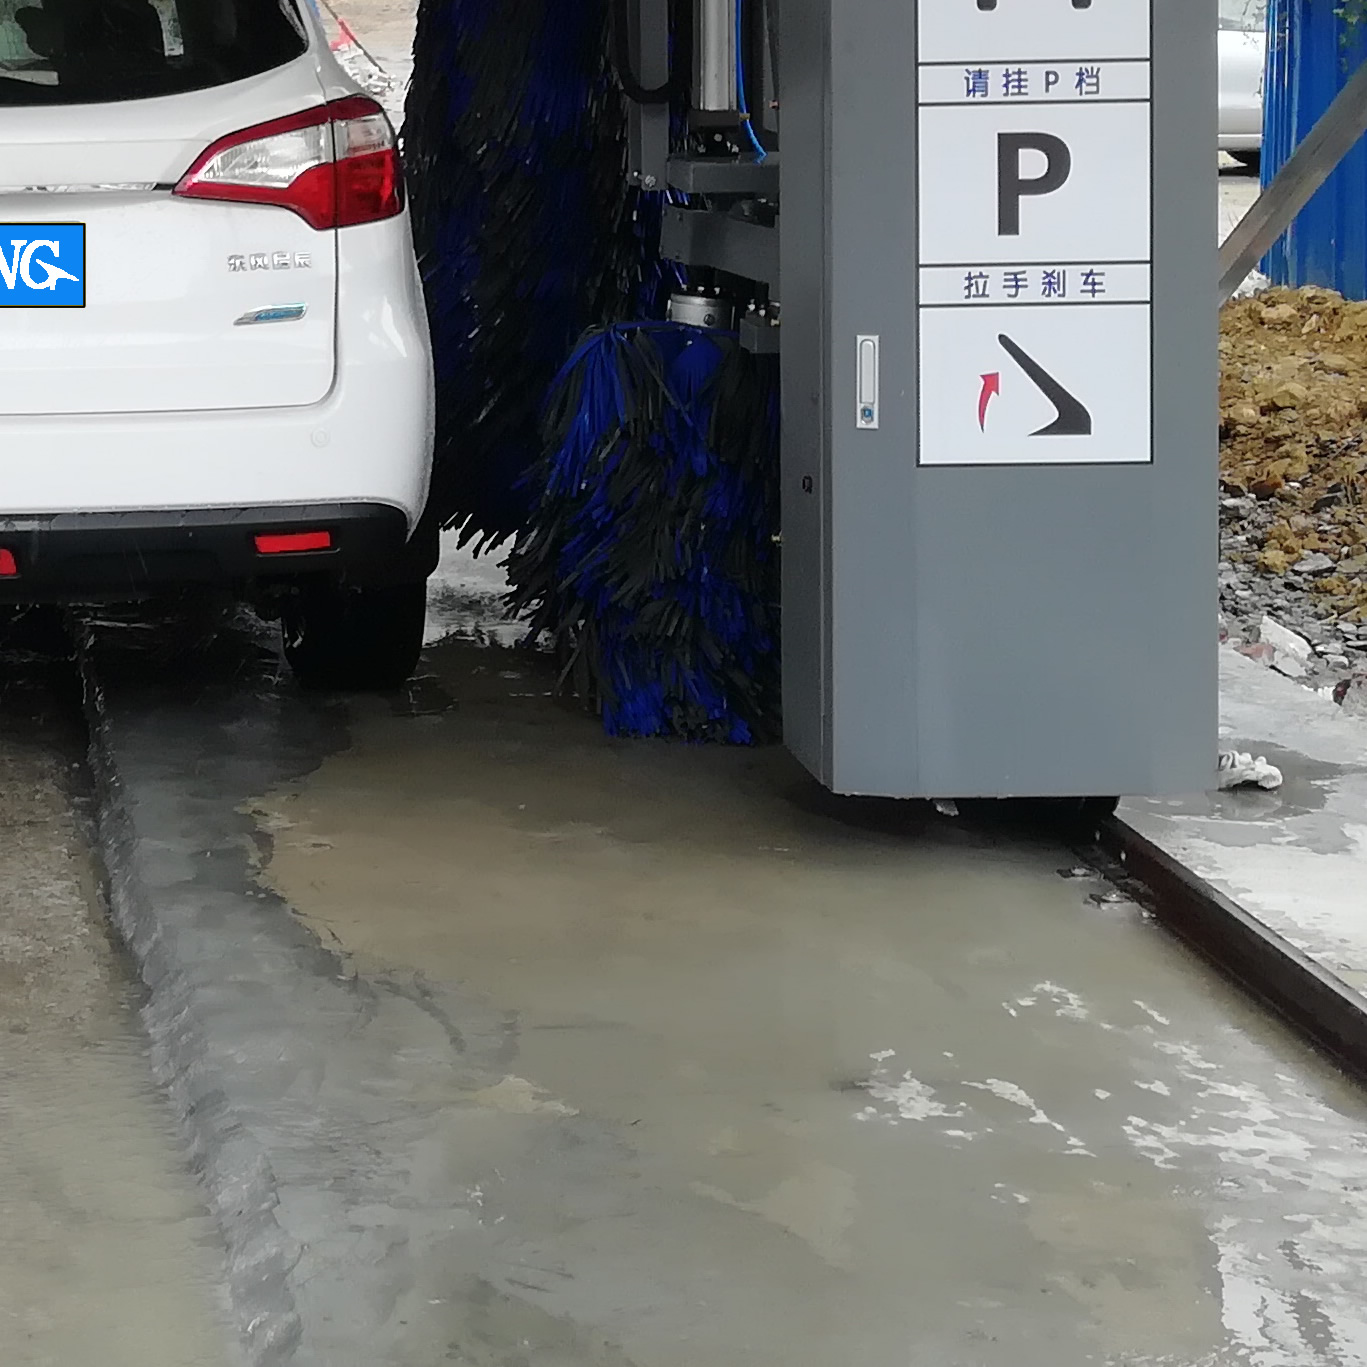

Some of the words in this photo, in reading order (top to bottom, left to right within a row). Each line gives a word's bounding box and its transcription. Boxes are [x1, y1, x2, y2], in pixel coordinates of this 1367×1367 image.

[963, 66, 1102, 99] 请挂P档
[997, 131, 1072, 237] P
[963, 269, 1107, 300] 拉手刹车
